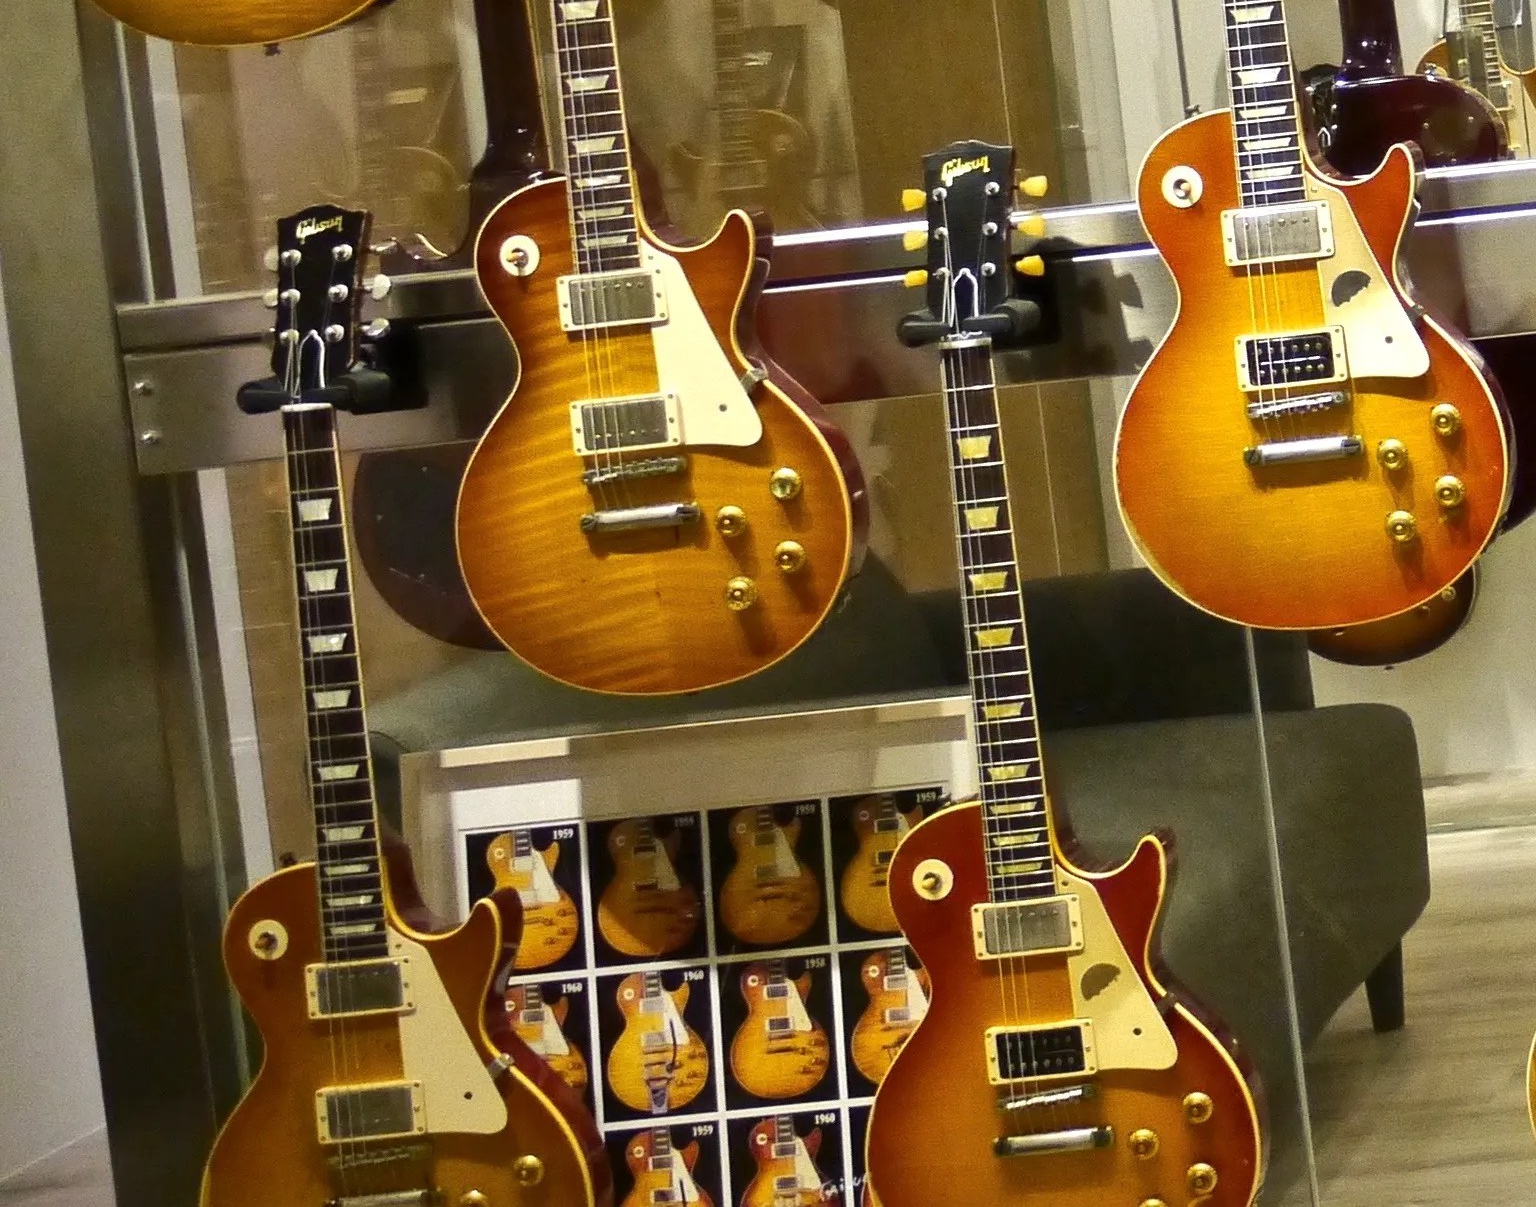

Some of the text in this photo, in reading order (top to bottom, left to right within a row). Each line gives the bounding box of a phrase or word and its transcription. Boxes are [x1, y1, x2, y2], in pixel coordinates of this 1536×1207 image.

[941, 155, 990, 187] Gibson
[296, 215, 345, 244] Gibson
[553, 828, 574, 840] 1959
[815, 1113, 836, 1125] 1960
[692, 1125, 714, 1137] 1959
